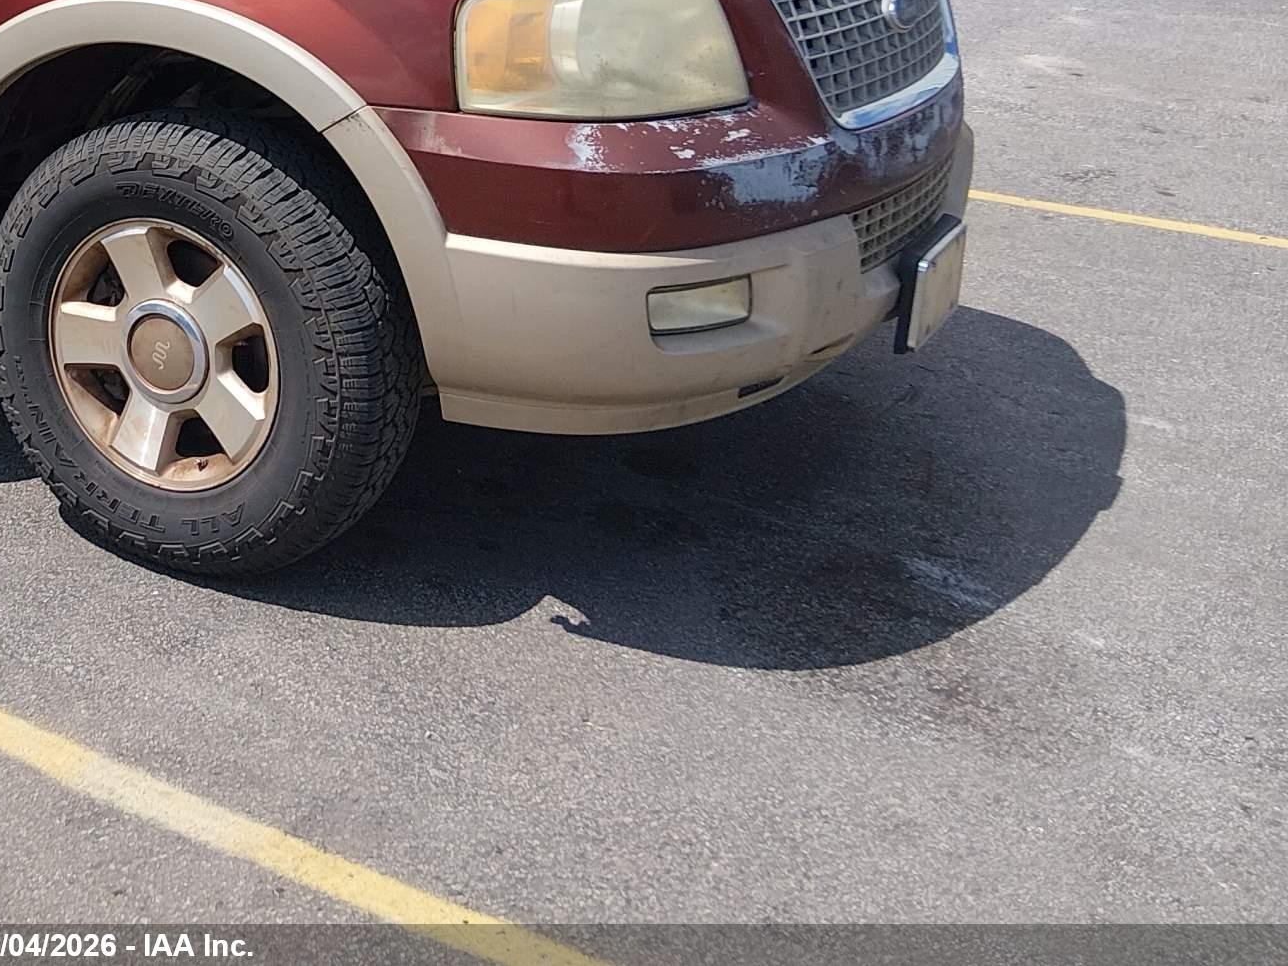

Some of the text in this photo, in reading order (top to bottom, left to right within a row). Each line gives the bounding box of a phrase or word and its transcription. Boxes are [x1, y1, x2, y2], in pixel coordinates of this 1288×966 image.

[115, 181, 235, 241] DEXTERO
[28, 405, 245, 536] ALL TERRAIN
